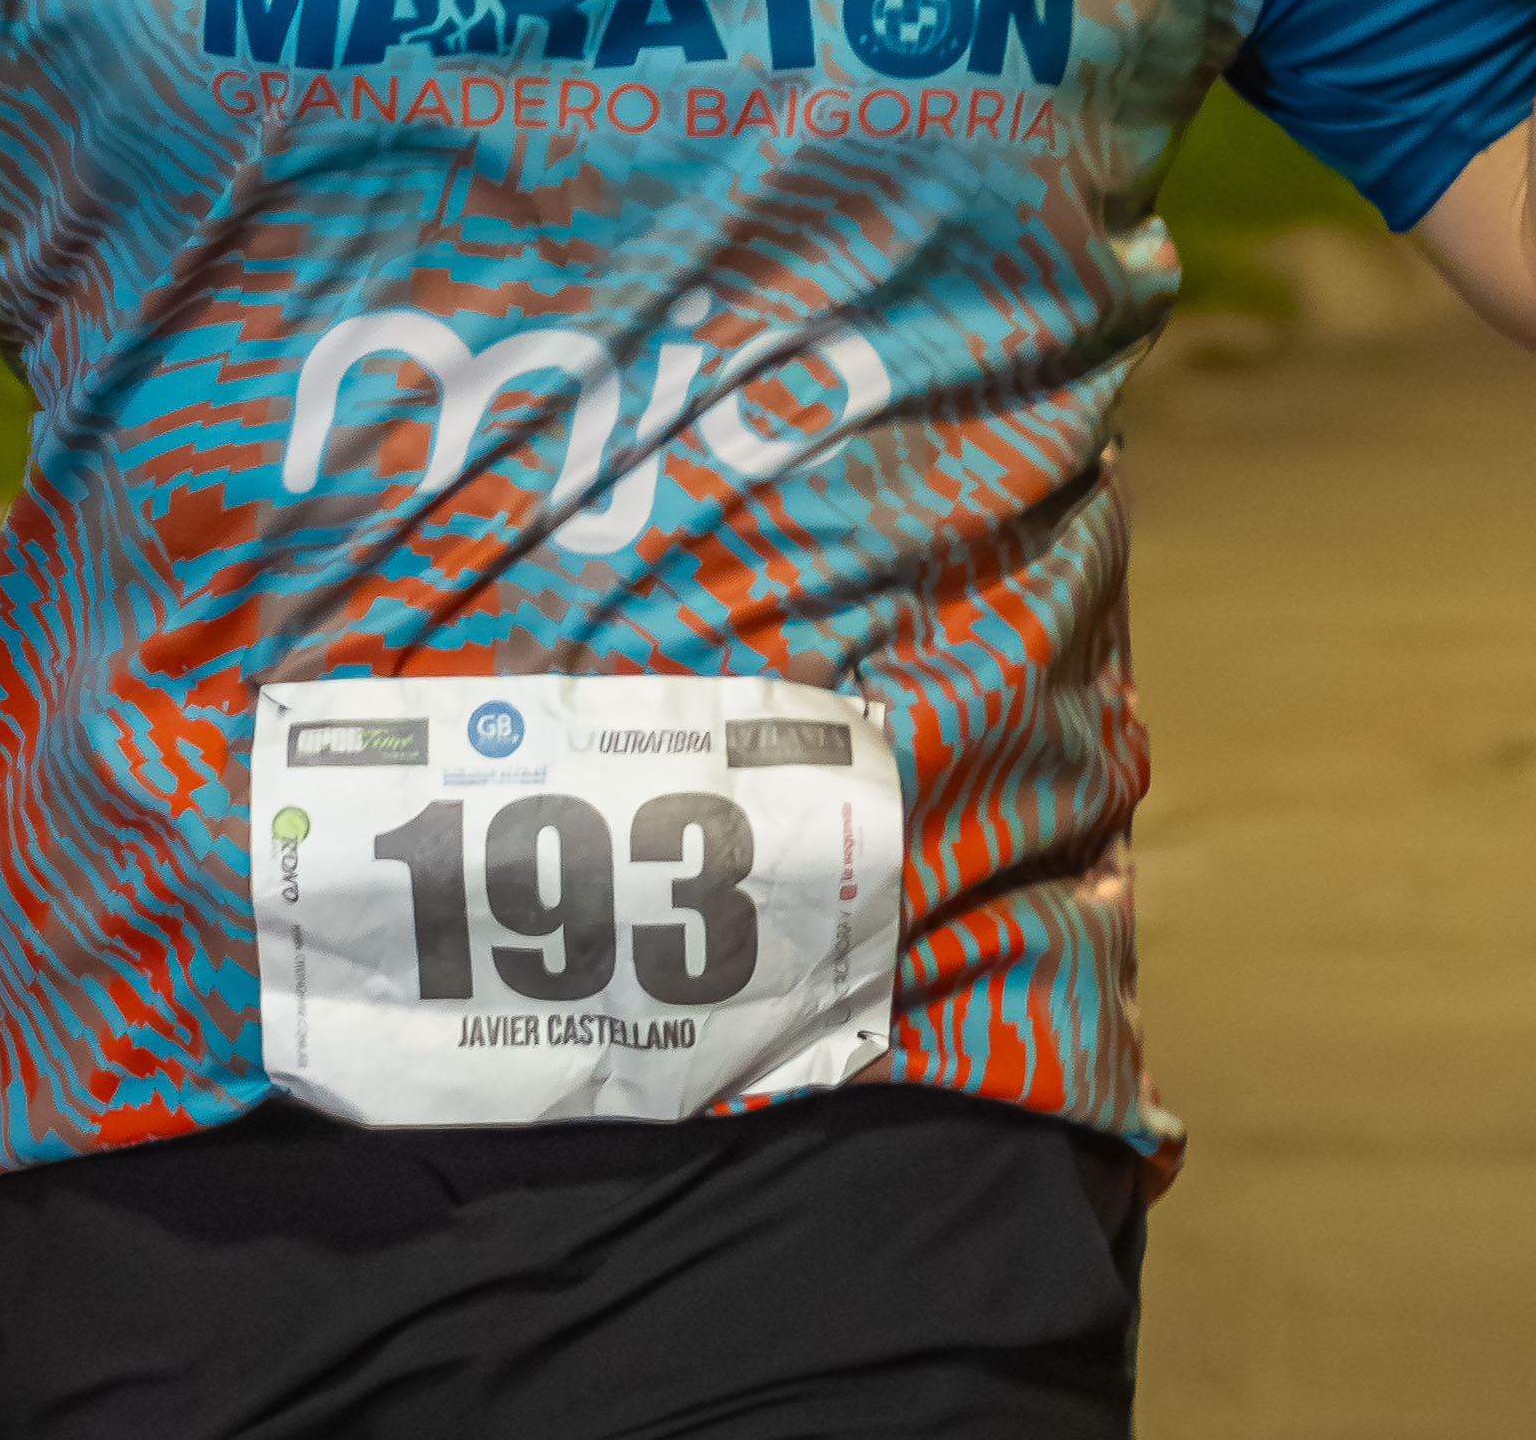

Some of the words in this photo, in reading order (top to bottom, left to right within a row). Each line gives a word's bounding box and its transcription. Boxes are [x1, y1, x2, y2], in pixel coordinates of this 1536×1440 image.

[211, 69, 661, 135] GRANADERO
[684, 85, 1057, 151] BAIGORRIA
[373, 791, 759, 1006] 193
[458, 1014, 540, 1048] JAVIER
[546, 1013, 697, 1050] CASTELLANO
